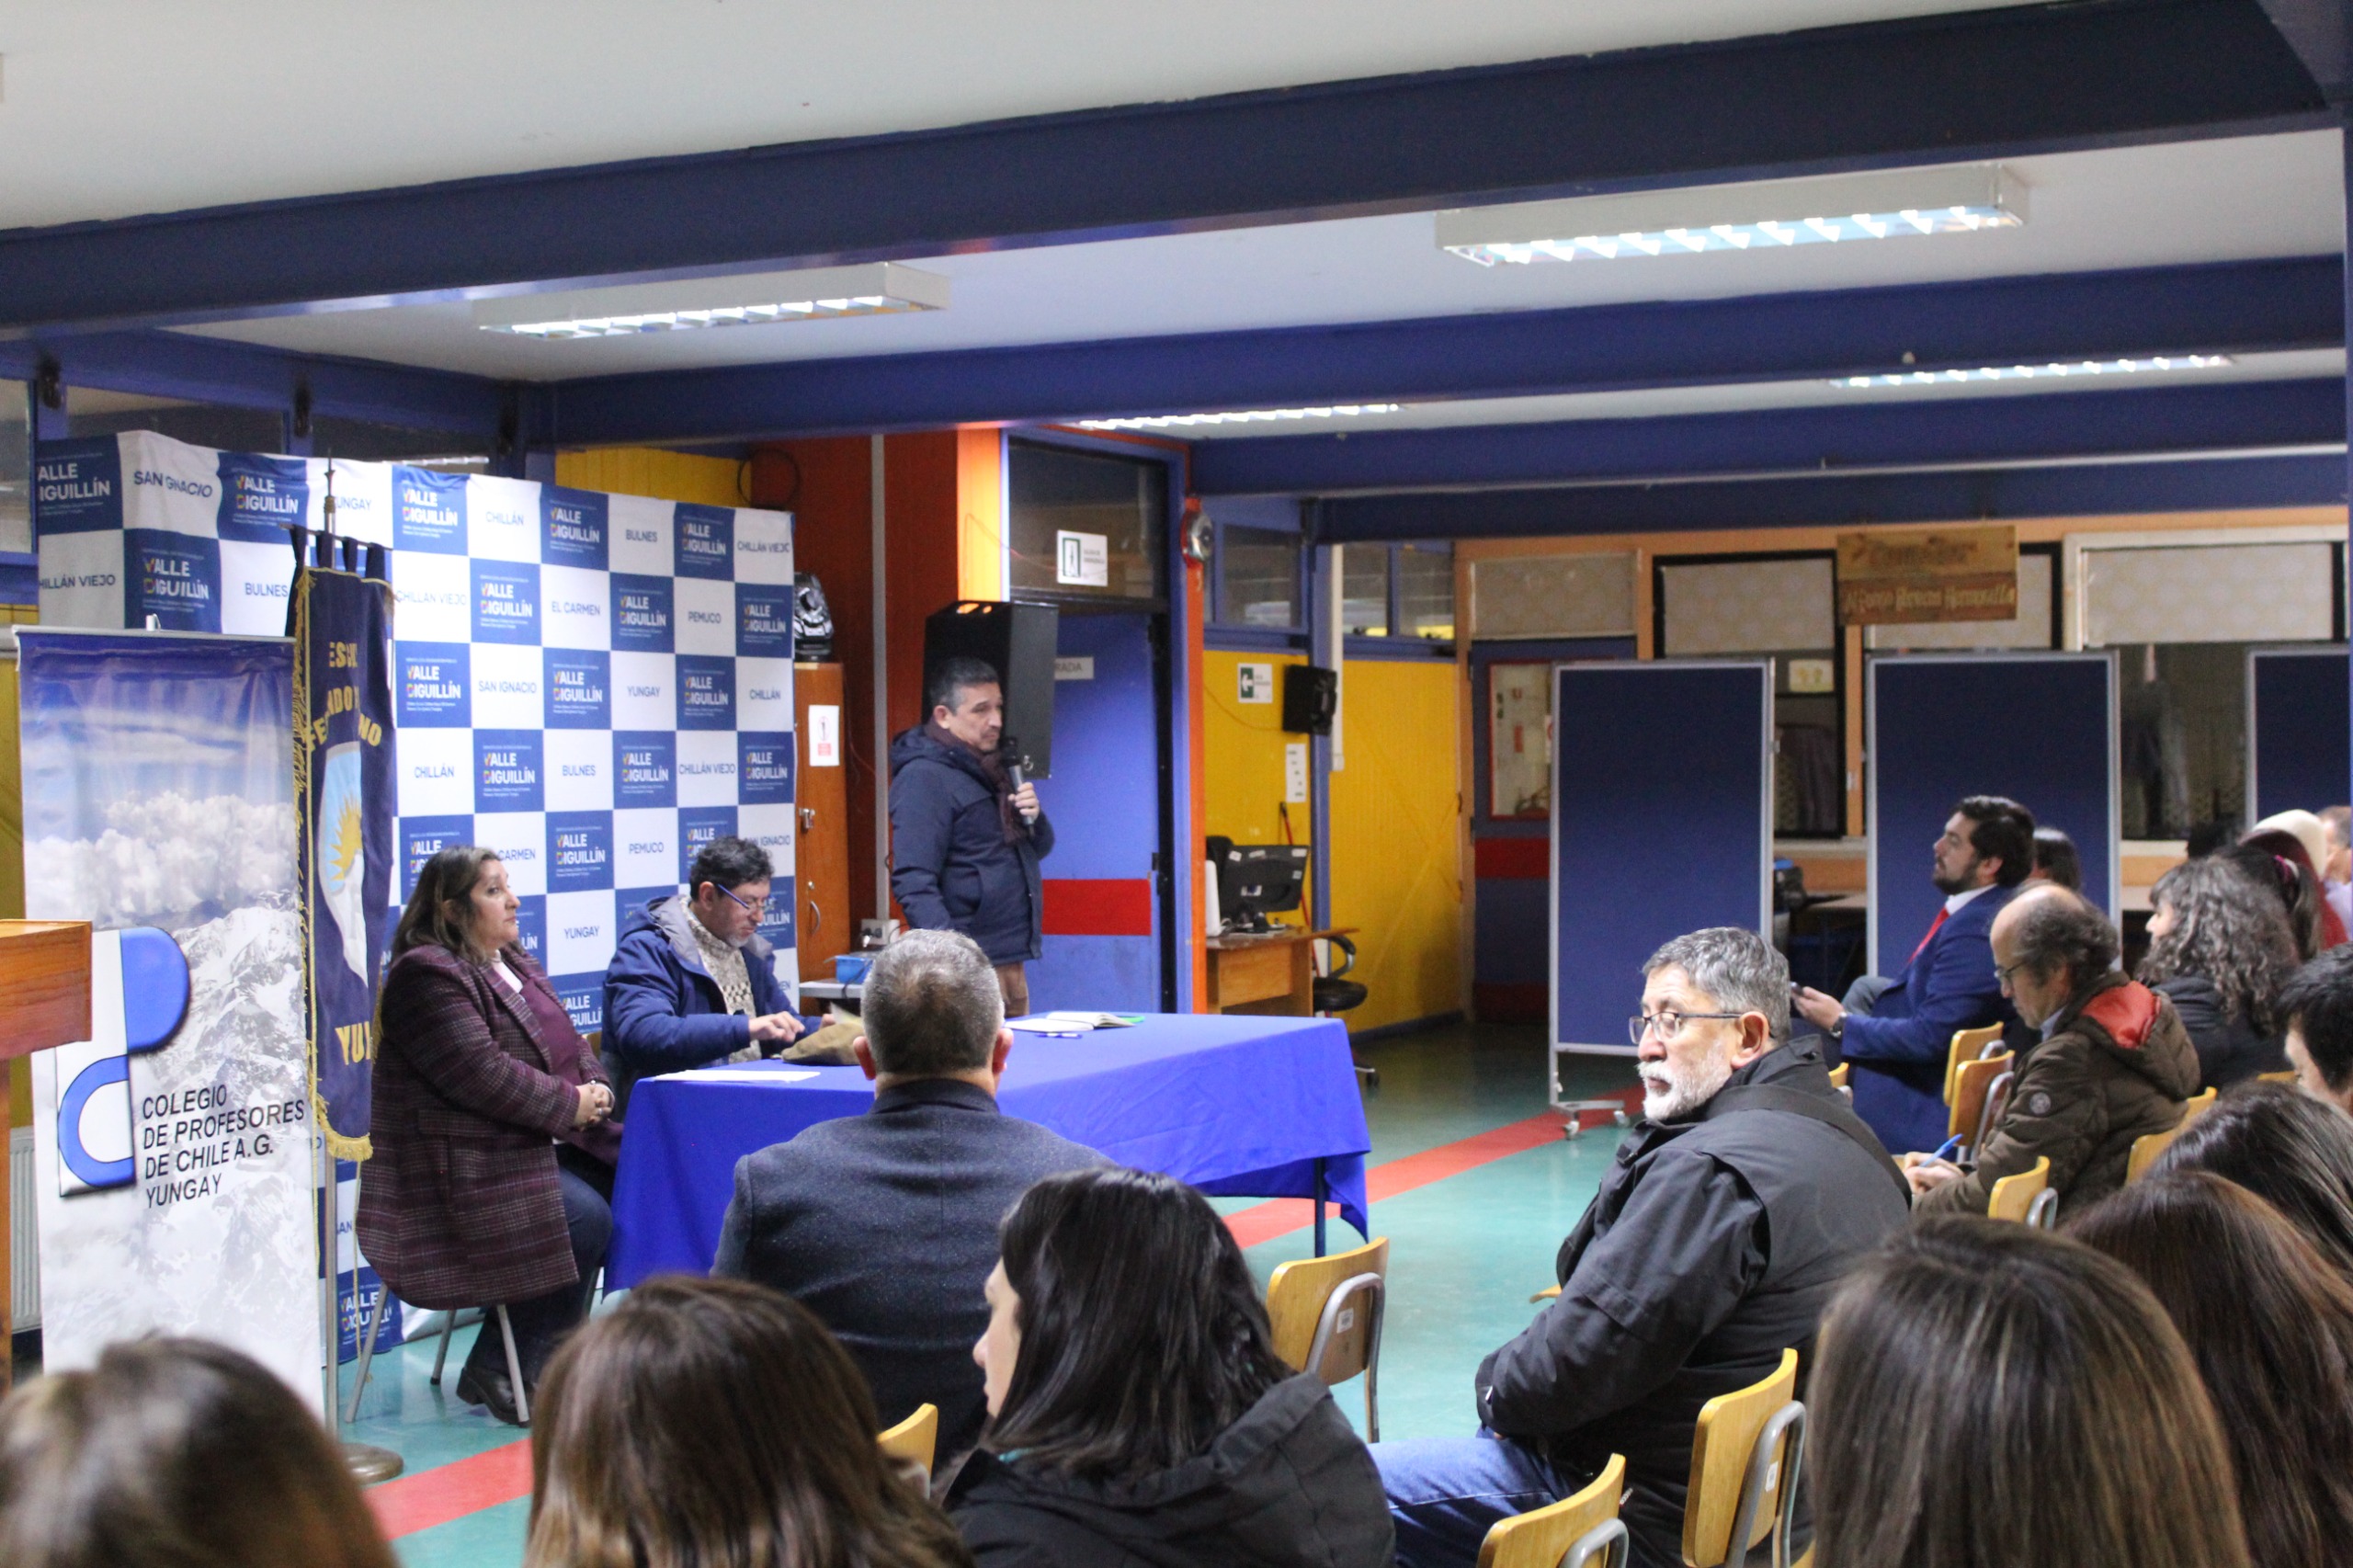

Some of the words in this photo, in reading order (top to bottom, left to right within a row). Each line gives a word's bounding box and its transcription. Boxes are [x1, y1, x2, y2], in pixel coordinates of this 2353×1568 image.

[38, 463, 78, 482] ALLE
[39, 477, 110, 502] IGUILLÍN
[133, 471, 164, 486] SAN
[165, 475, 213, 498] GNACIO
[235, 475, 275, 494] VALLE
[235, 494, 299, 514] DIGUILLÍN
[335, 497, 372, 510] UNGAY
[404, 488, 438, 507] VALLE
[403, 506, 459, 527] DIGUILLÍN
[551, 507, 581, 524] VALLE
[550, 524, 600, 543] DIGUILLÍN
[625, 528, 658, 543] BULNES
[683, 522, 710, 538] VALLE
[142, 557, 190, 577] VALLE
[40, 574, 75, 589] HILLÁN
[78, 574, 116, 587] VIEJO
[244, 582, 289, 597] BULNES
[481, 583, 514, 599] VALLE
[480, 599, 532, 618] DIGUILLÍN
[551, 601, 562, 613] EL
[563, 602, 600, 616] CARMEN
[620, 596, 649, 609] VALLE
[620, 610, 666, 627] DIGUILLÍN
[688, 611, 722, 624] PEMUCO
[744, 605, 770, 618] VALLE
[407, 665, 440, 681] VALLE
[553, 671, 585, 686] VALLE
[406, 680, 461, 699] DIGUILLÍN
[478, 680, 497, 692] SAN
[499, 681, 537, 694] IGNACIO
[685, 676, 712, 689] VALLE
[553, 685, 603, 702] DIGUILLÍN
[627, 686, 661, 698] YUNGAY
[749, 687, 780, 700] CHILLÁN
[483, 752, 517, 767] VALLE
[622, 752, 652, 766] VALLE
[746, 752, 773, 765] VALLE
[414, 763, 455, 778] CHILLÁN
[483, 767, 535, 784] DIGUILLÍN
[563, 765, 596, 777] BULNES
[621, 766, 669, 782] DIGUILLÍN
[679, 761, 712, 775] CHILLÁN
[713, 763, 736, 774] VIEJO
[556, 834, 587, 848] VALLE
[688, 827, 715, 841] VALLE
[760, 835, 791, 846] IGNACIO
[410, 840, 442, 856] VALLE
[556, 846, 606, 865] DIGUILLÍN
[629, 842, 664, 855] PEMUCO
[564, 926, 599, 939] YUNGAY
[563, 995, 590, 1011] ALLE
[570, 1006, 602, 1027] GUILLÍ
[142, 1084, 228, 1120] COLEGIO
[143, 1124, 168, 1150] DE
[175, 1099, 305, 1144] PROFESORES
[145, 1153, 170, 1179] DE
[176, 1141, 230, 1173] CHILE
[146, 1173, 222, 1210] YUNGAY
